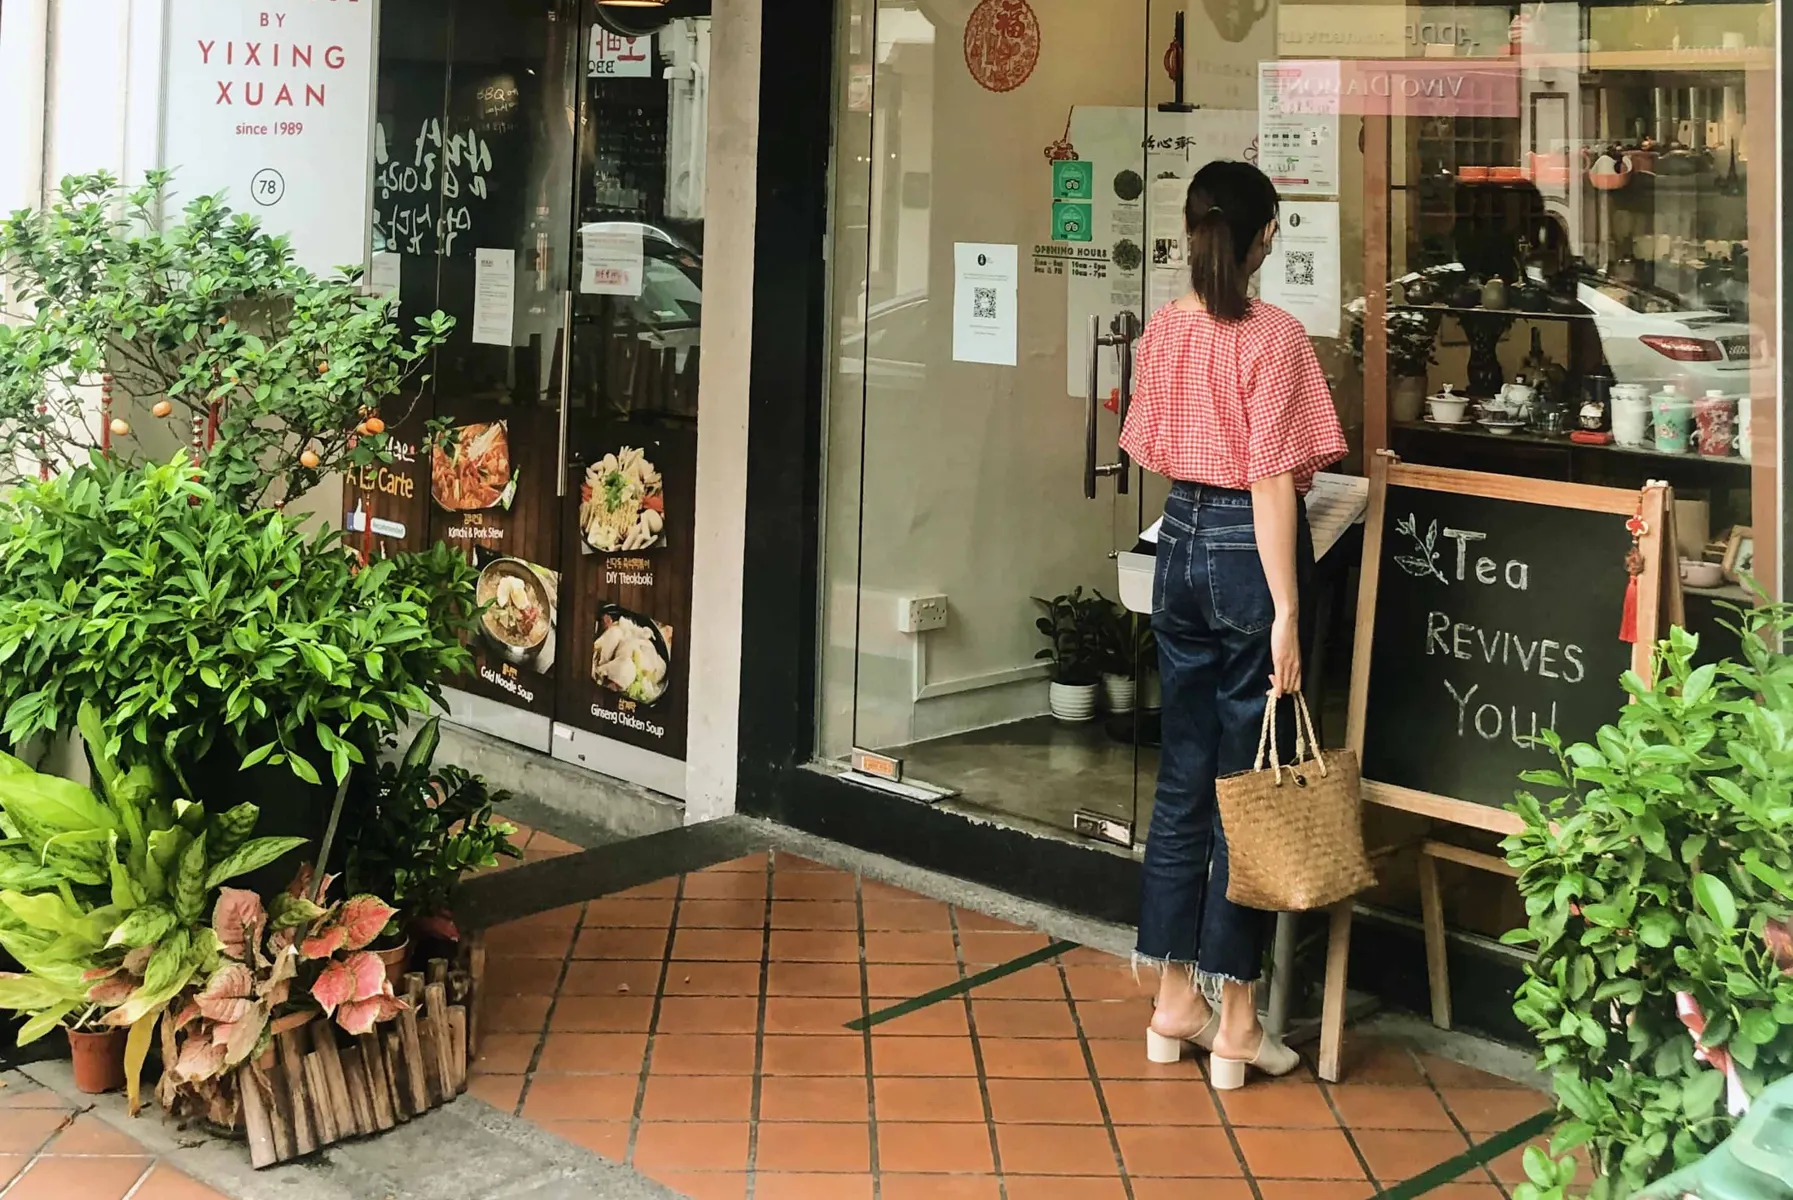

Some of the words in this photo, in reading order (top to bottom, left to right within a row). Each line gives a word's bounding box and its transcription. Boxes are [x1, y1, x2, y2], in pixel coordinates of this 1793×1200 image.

[260, 12, 286, 28] BY
[198, 40, 346, 70] YIXING
[216, 81, 326, 107] XUAN
[235, 121, 268, 137] since
[273, 121, 303, 137] 1989
[259, 180, 276, 195] 78
[1035, 245, 1073, 255] OPENING
[1077, 247, 1107, 257] HOURS
[378, 467, 413, 498] Carte
[448, 526, 467, 539] Kimchi
[473, 526, 487, 539] Pork
[488, 527, 504, 539] Stew
[1443, 527, 1528, 591] Tea
[606, 571, 617, 584] DIY
[1426, 611, 1584, 683] REVIVES
[480, 666, 495, 682] Cold
[495, 673, 517, 694] Noodle
[517, 684, 533, 703] Soup
[590, 703, 617, 724] Ginseng
[618, 712, 645, 731] Chicken
[646, 720, 664, 738] Soup
